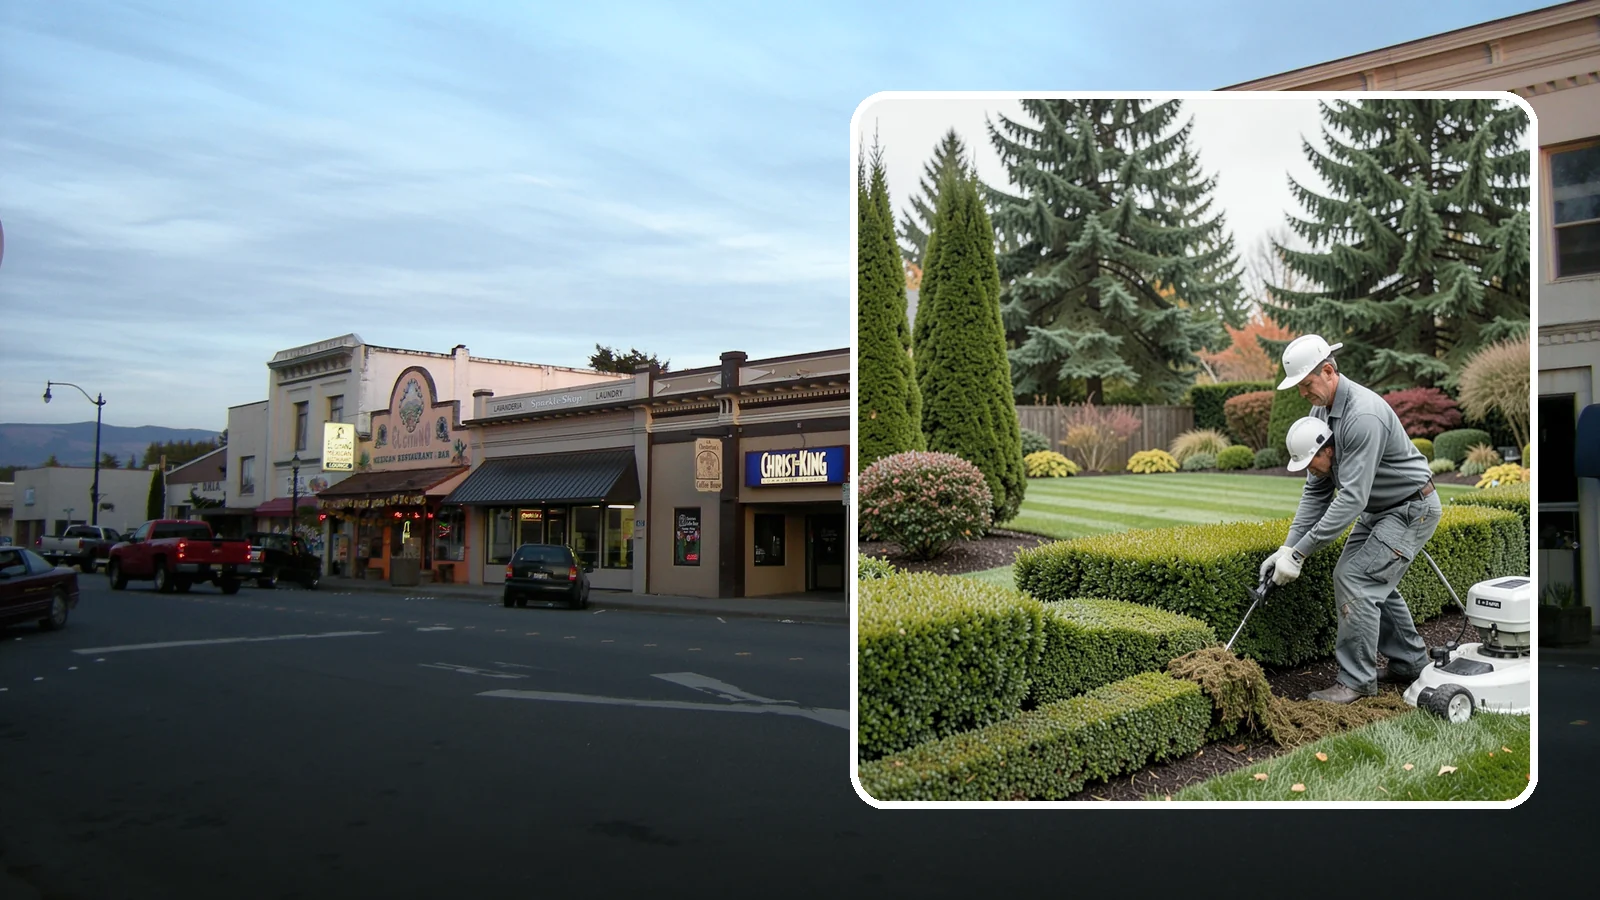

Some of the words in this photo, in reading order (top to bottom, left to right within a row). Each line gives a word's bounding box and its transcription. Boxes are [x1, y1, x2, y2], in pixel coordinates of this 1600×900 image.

[494, 402, 522, 412] LAVANDERIA
[531, 397, 560, 408] Sparkle
[562, 395, 582, 405] Shop
[595, 389, 623, 400] LAUNDRY
[373, 455, 396, 464] MEXICAN
[397, 452, 433, 462] RESTAURANT
[437, 450, 450, 459] BAR
[761, 452, 797, 477] CHRIST
[799, 450, 827, 476] KING
